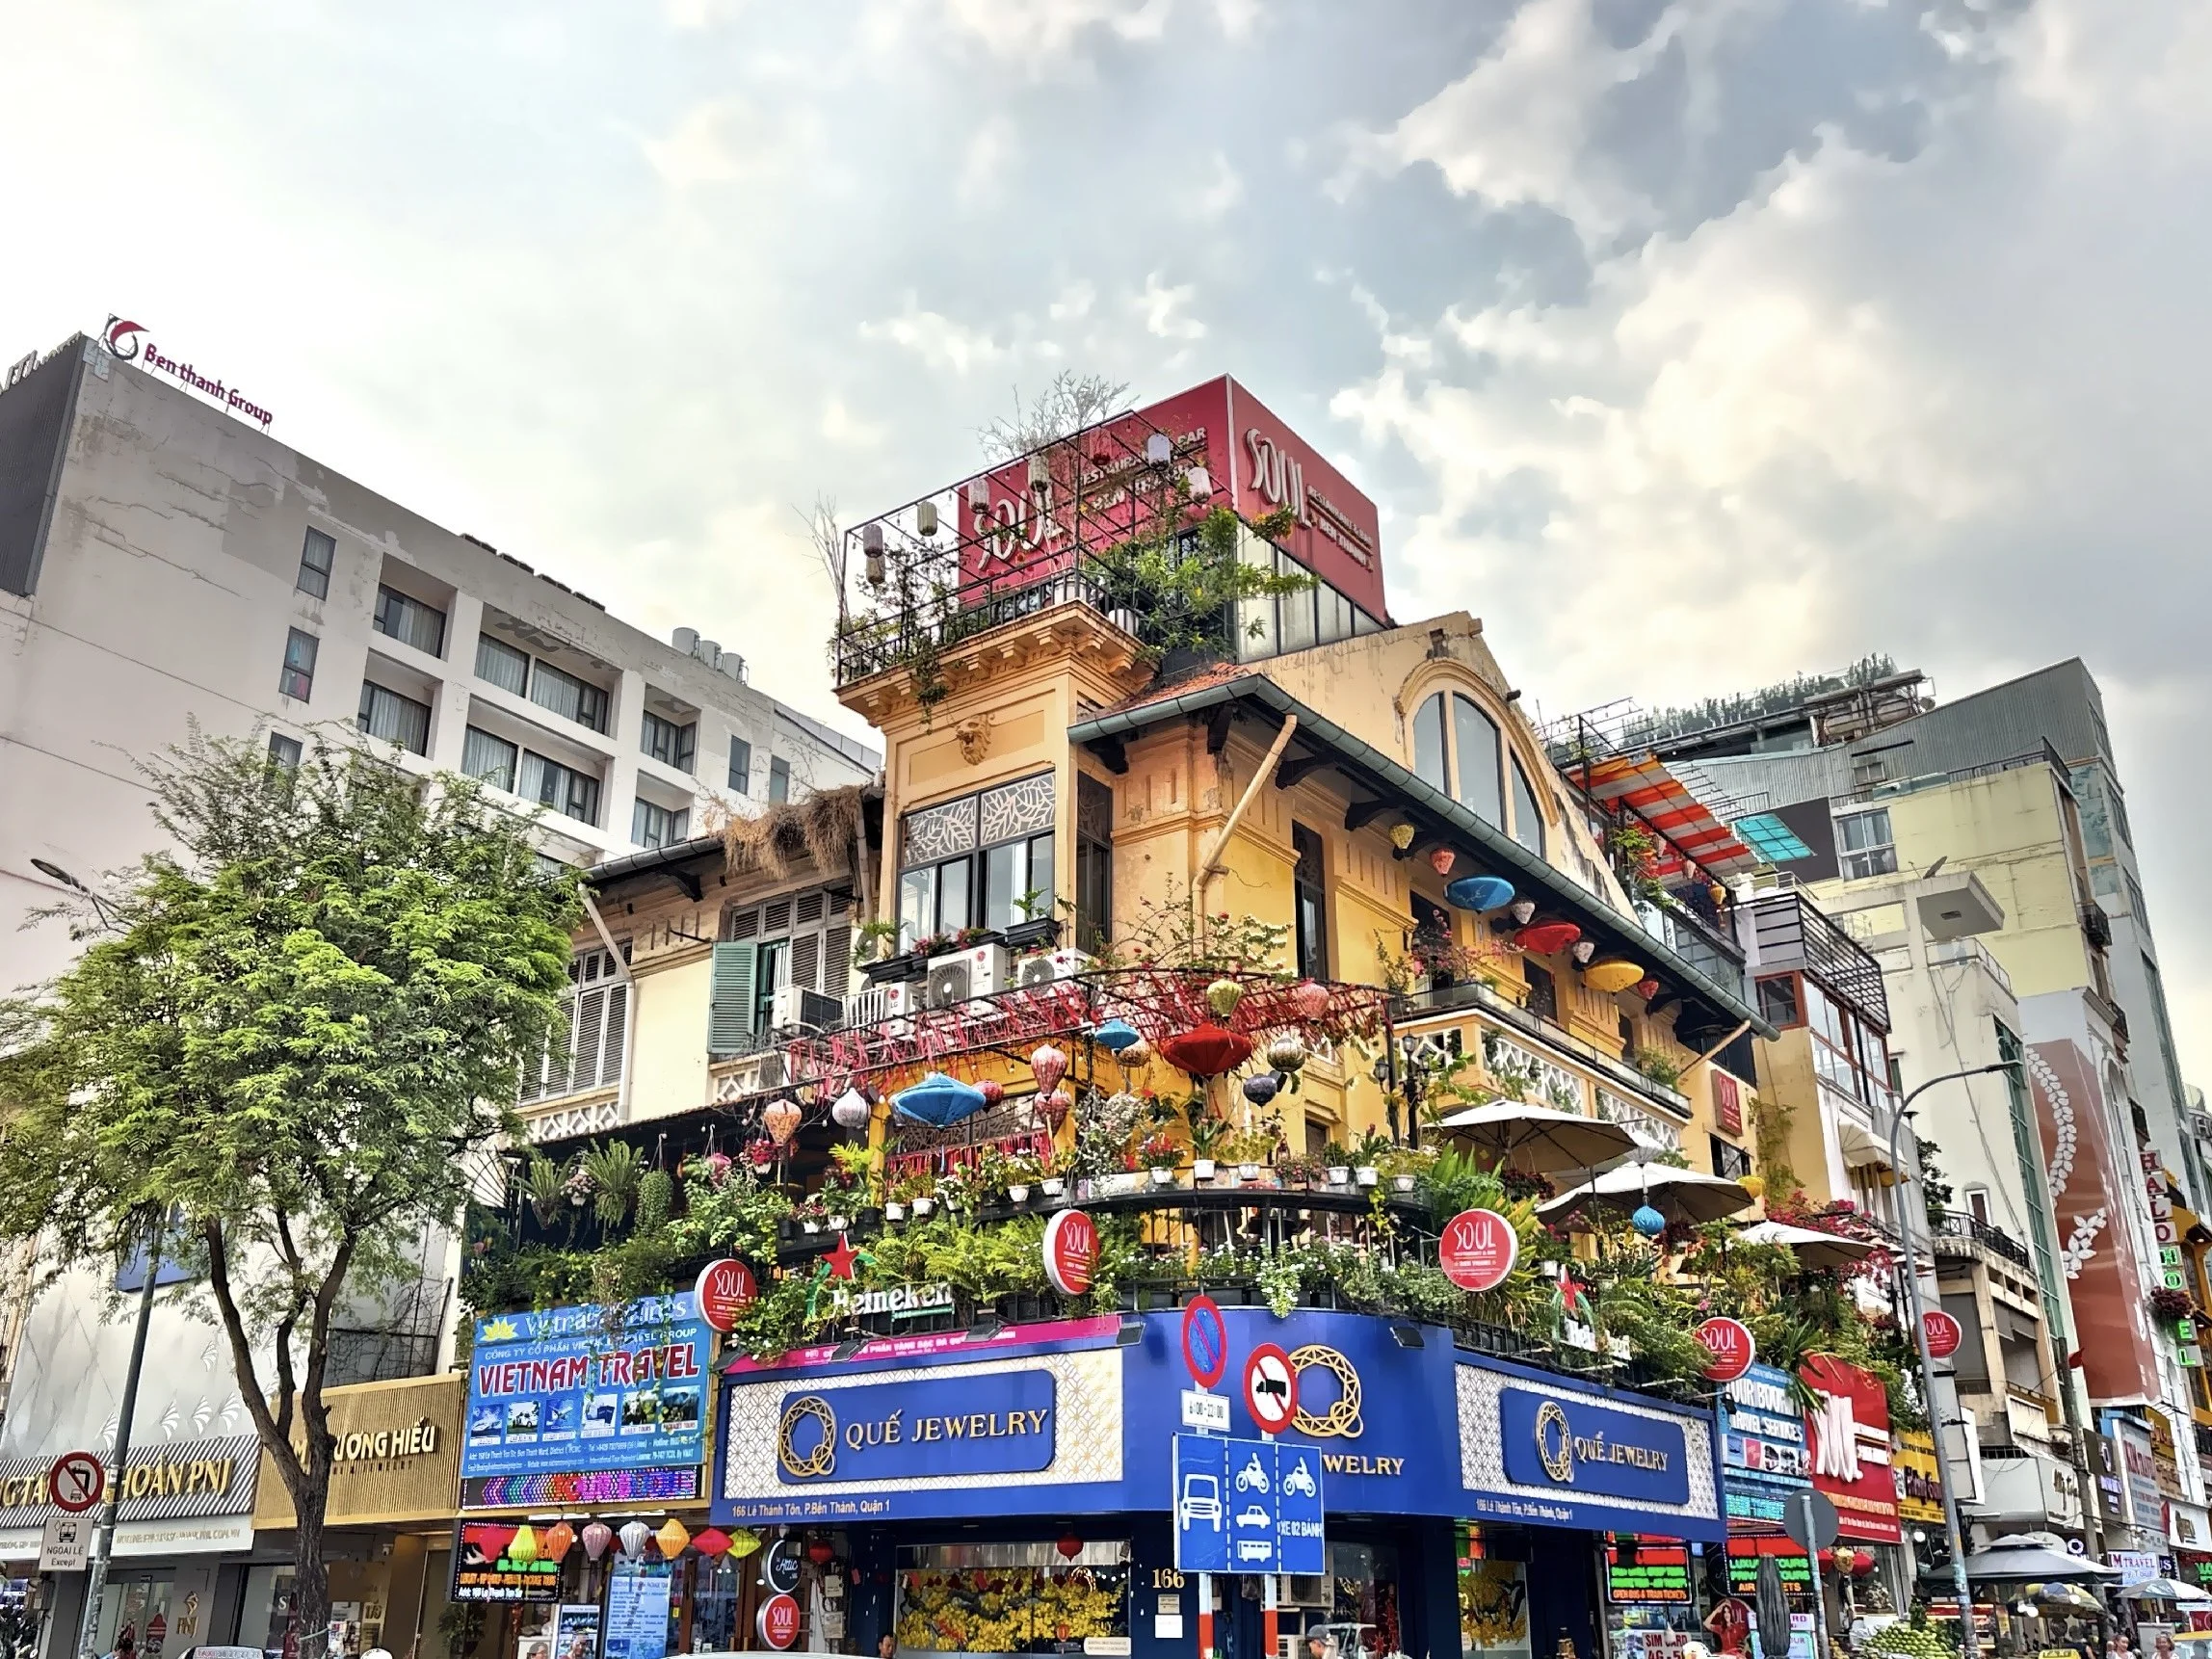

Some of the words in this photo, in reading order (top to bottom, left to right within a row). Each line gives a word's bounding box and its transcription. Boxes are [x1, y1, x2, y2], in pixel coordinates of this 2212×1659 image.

[228, 389, 273, 425] Group
[1246, 428, 1313, 529] SOUL
[1064, 1221, 1091, 1253] SOUL
[1454, 1220, 1496, 1251] SOUL
[714, 1269, 746, 1297] SOUL
[1926, 1317, 1949, 1335] OUL
[1701, 1327, 1738, 1350] SOUL
[514, 1348, 525, 1356] TY
[479, 1356, 590, 1397] VIETNAM
[597, 1342, 701, 1387] TRAVEL
[846, 1409, 904, 1450] QUẾ
[911, 1409, 1048, 1442] JEWELRY
[1573, 1431, 1606, 1463] QUẾ
[1610, 1442, 1669, 1472] JEWELRY
[1324, 1454, 1405, 1476] WELRY
[187, 1458, 232, 1496] PNJ
[732, 1505, 746, 1517] 166
[885, 1499, 890, 1512] 1
[1280, 1520, 1291, 1536] XE
[1291, 1521, 1301, 1537] 02
[1302, 1517, 1322, 1538] BÁNH
[51, 1558, 76, 1567] Except
[2123, 1558, 2154, 1568] TRAVEL
[1152, 1567, 1185, 1589] 166
[1779, 1569, 1810, 1580] OURS
[1738, 1582, 1755, 1592] AIR
[773, 1607, 793, 1625] SOUL
[1646, 1634, 1663, 1647] SIM
